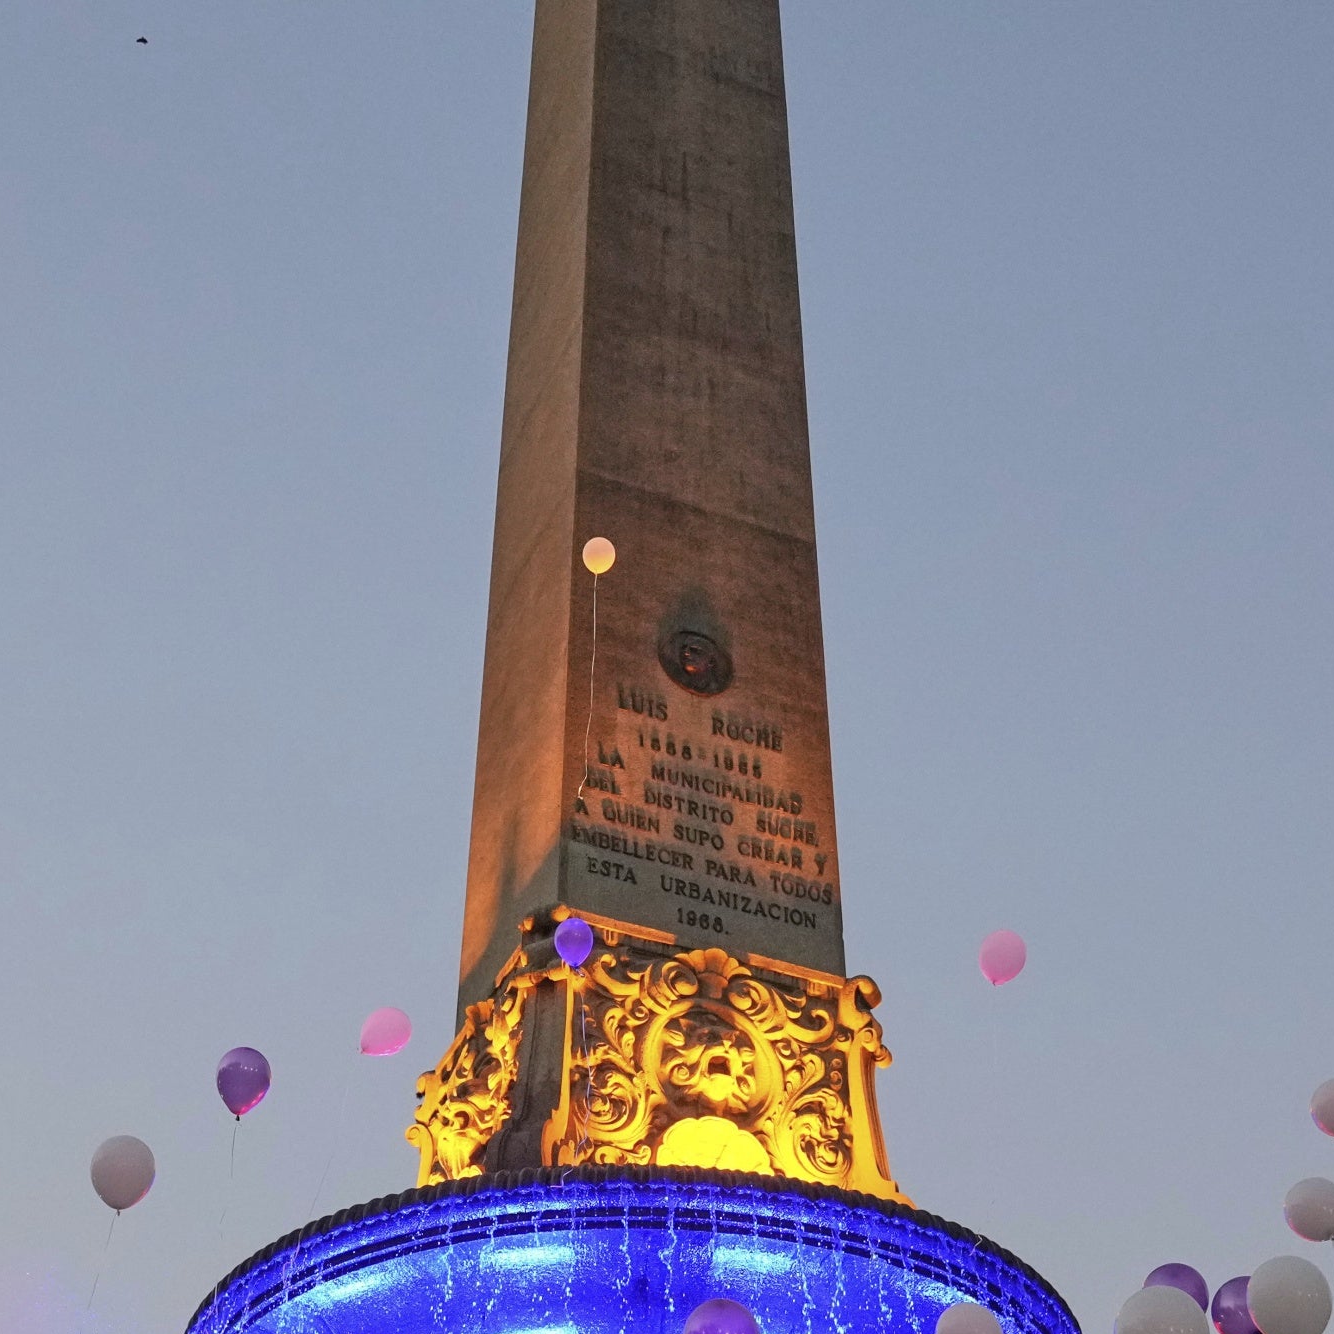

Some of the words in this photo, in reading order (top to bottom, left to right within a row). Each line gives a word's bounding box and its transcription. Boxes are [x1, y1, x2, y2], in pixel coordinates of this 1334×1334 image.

[617, 688, 668, 721] LUIS
[712, 713, 782, 752] ROCHE
[598, 742, 625, 769] LA
[650, 762, 802, 815] MUNICIPALIDAD
[644, 784, 734, 825] DISTRITO
[570, 822, 694, 870] EMBELLECER
[705, 859, 757, 887] PARA
[769, 871, 834, 905] TODOS
[574, 799, 589, 815] A
[603, 799, 660, 833] QUIEN
[673, 824, 725, 851] SUPO
[737, 838, 803, 871] CREAR
[814, 853, 828, 876] Y
[587, 856, 637, 885] ESTA
[661, 874, 817, 929] URBANIZACION
